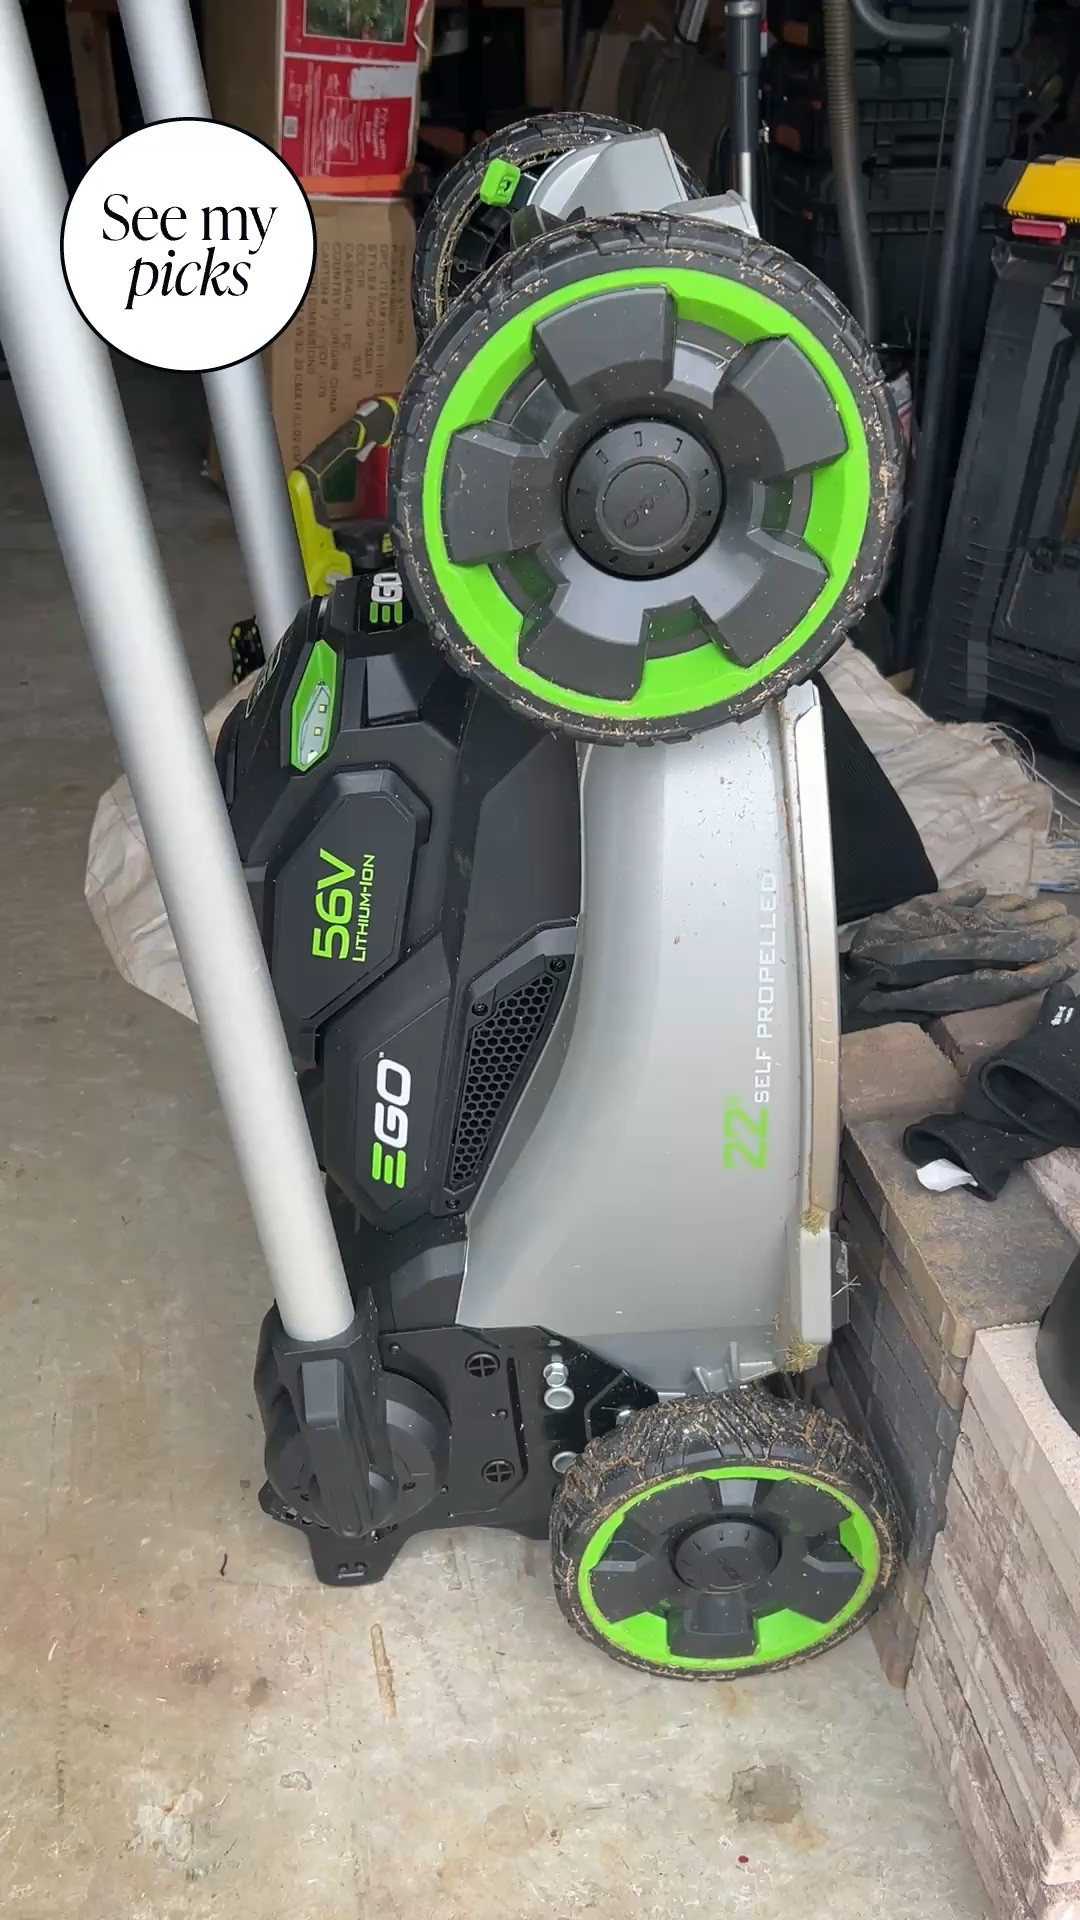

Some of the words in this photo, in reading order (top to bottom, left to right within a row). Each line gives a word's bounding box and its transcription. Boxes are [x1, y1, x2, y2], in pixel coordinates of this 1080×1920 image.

[331, 242, 342, 305] COUNTRY
[369, 572, 403, 625] EGO
[312, 848, 356, 959] 56V
[756, 873, 778, 1039] PROPELLED
[754, 1047, 773, 1104] SELF
[371, 1058, 412, 1189] EGO
